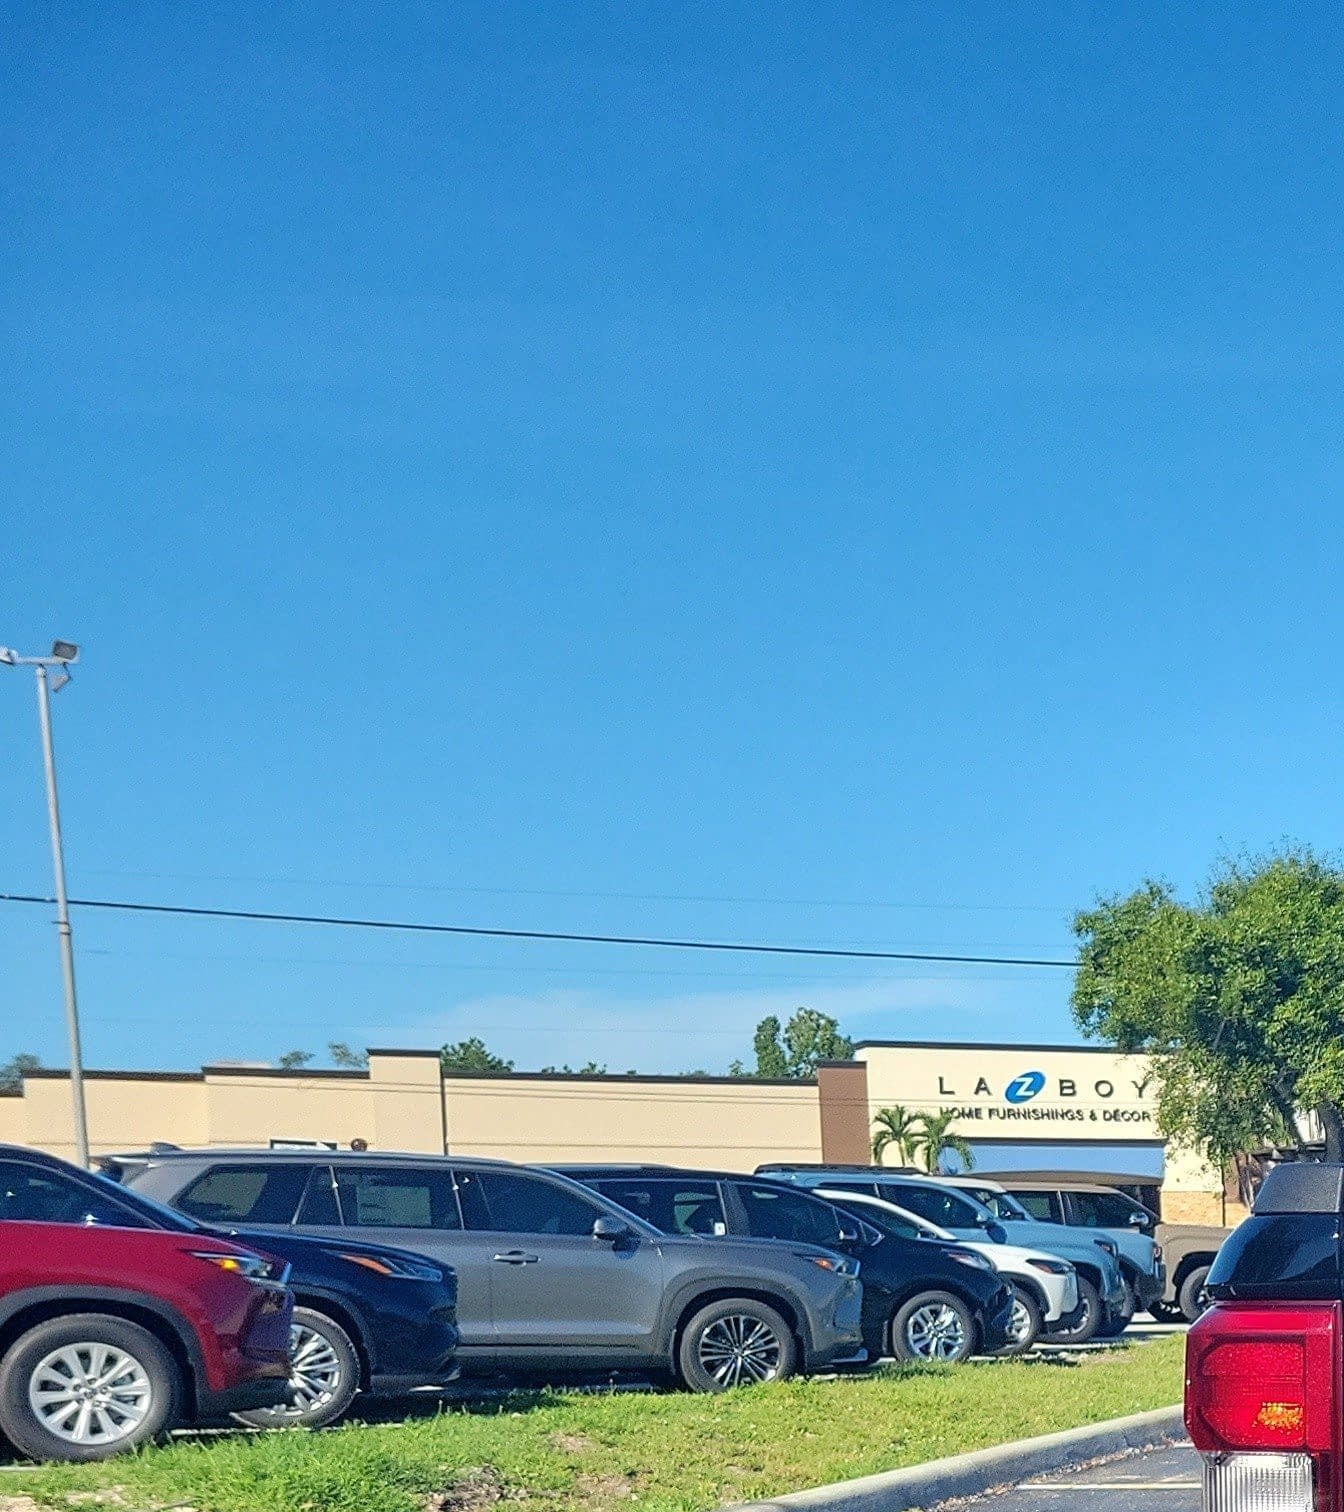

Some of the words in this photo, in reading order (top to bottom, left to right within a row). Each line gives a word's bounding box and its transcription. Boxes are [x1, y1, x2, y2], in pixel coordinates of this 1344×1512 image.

[940, 1106, 983, 1120] HOME
[988, 1107, 1084, 1121] FURNISHINGS
[1089, 1109, 1098, 1121] &
